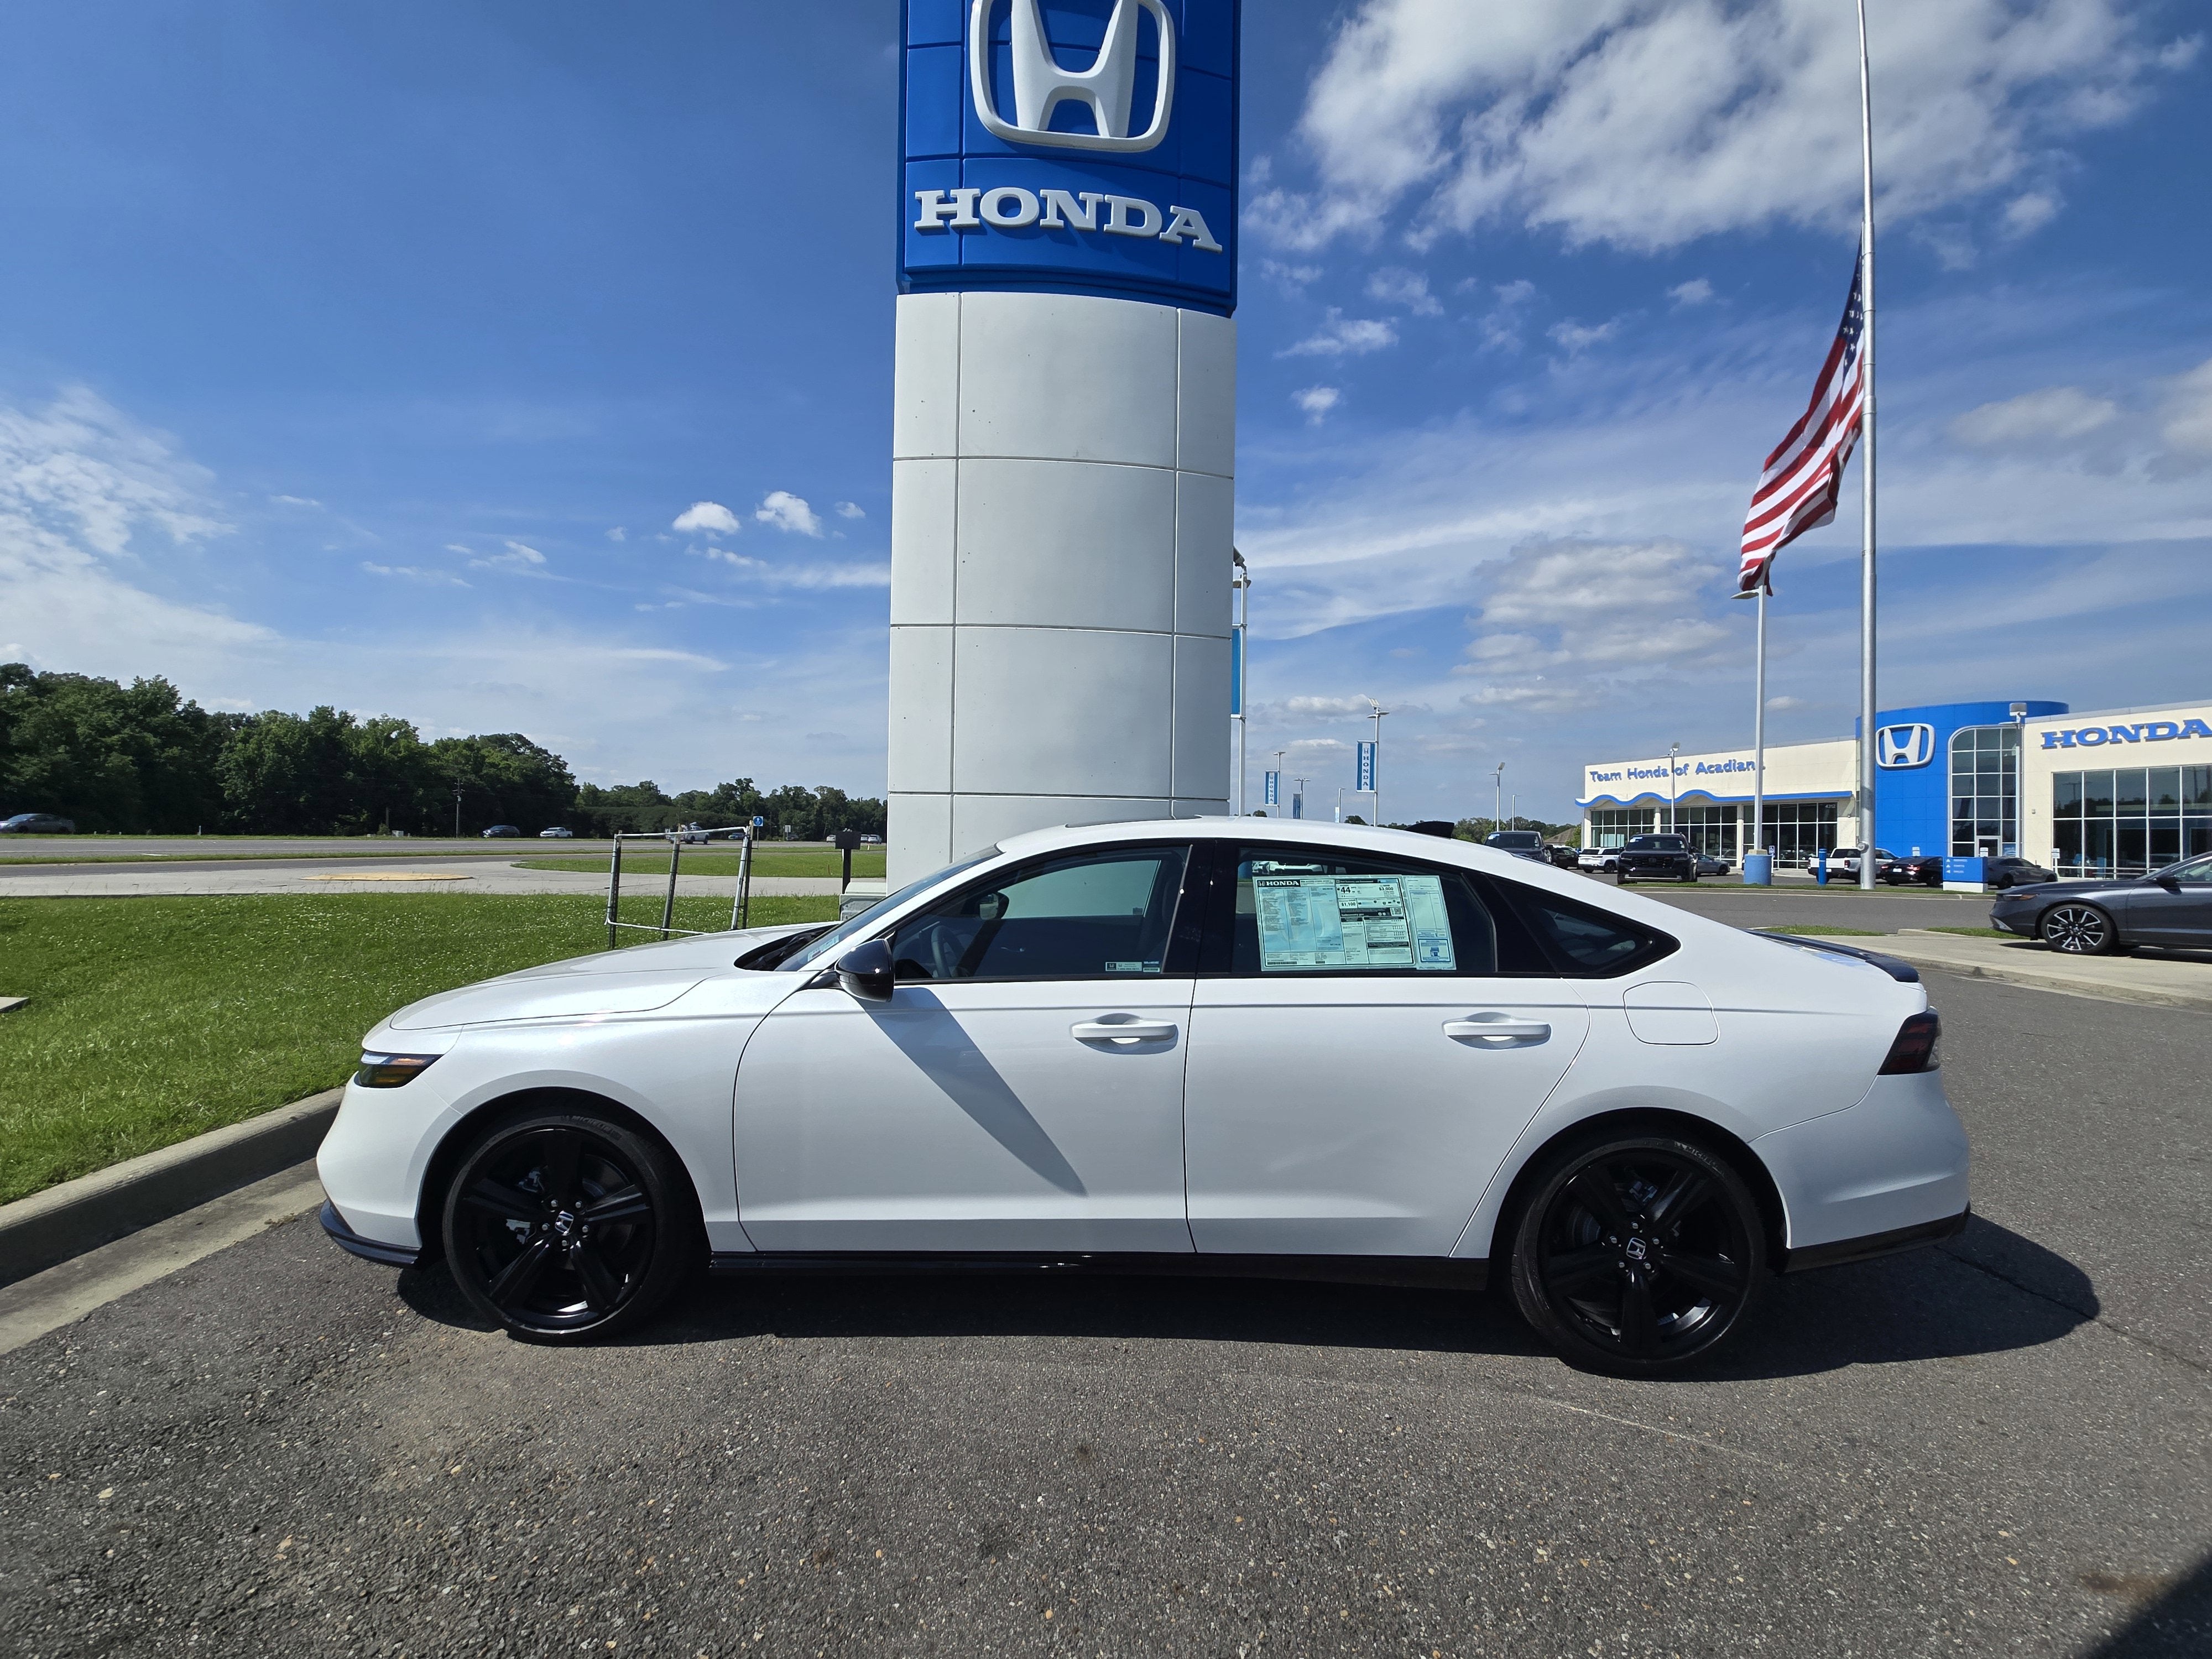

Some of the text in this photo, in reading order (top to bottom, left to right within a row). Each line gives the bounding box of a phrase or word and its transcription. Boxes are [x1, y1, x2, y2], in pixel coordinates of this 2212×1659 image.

[914, 187, 1223, 253] HONDA
[2041, 718, 2212, 750] HONDA
[1589, 759, 1766, 782] Team Honda of Acadian
